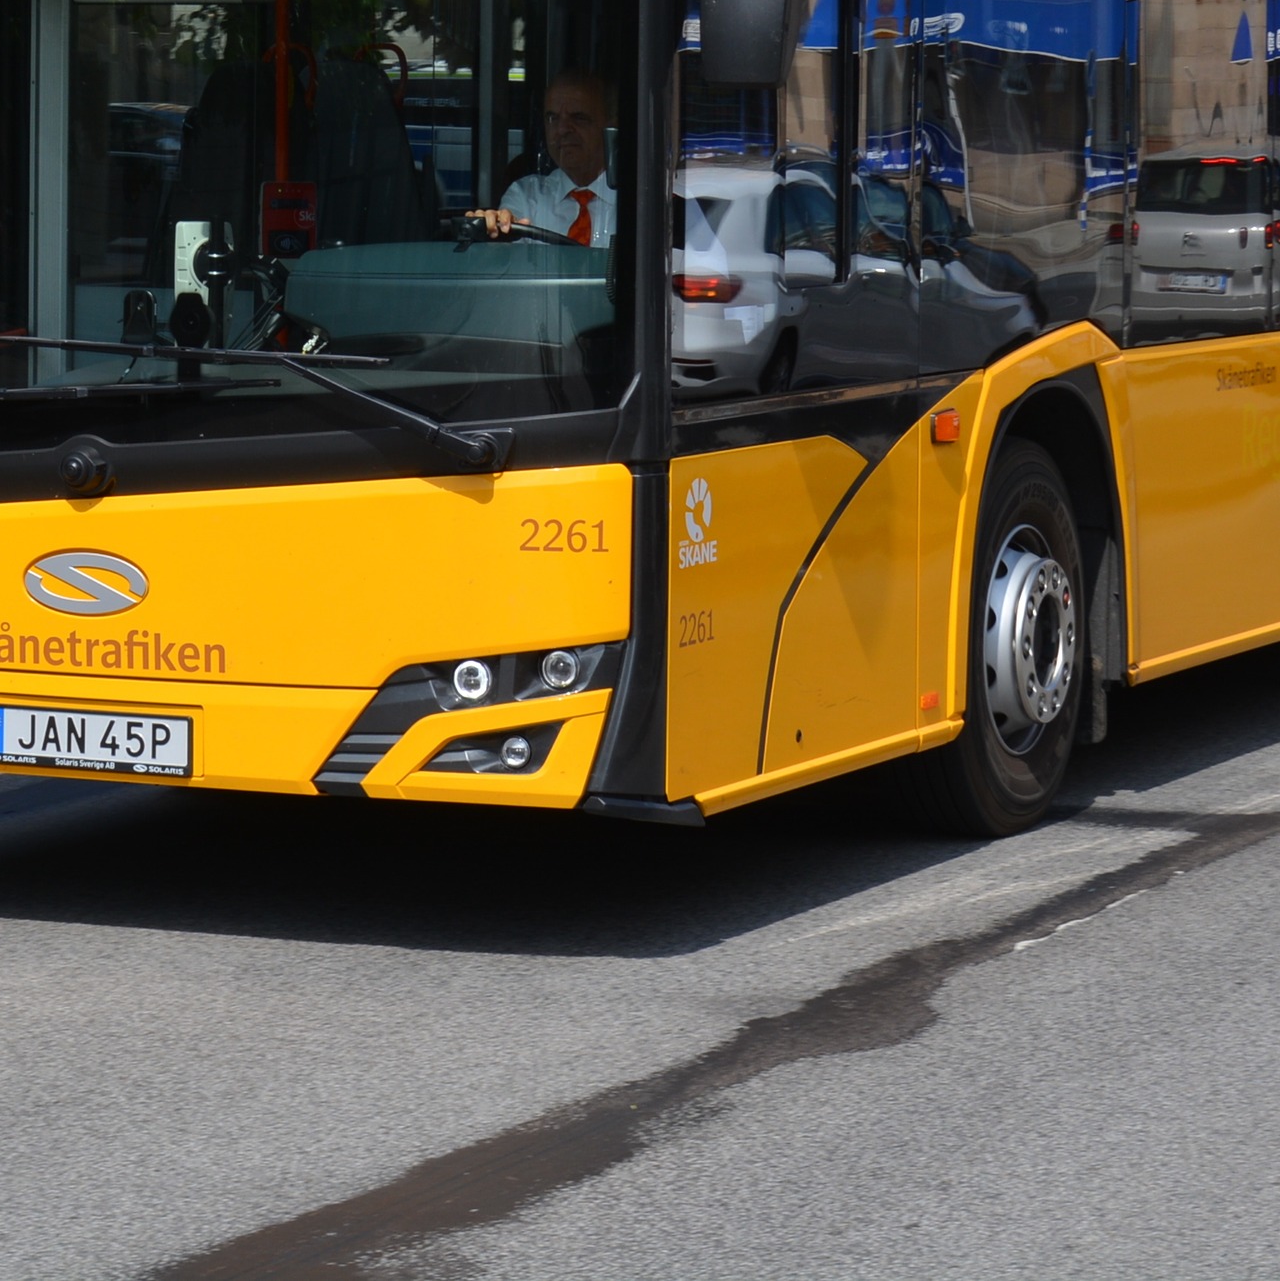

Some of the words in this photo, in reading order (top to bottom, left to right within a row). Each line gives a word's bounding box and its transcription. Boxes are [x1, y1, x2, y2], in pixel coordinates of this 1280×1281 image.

[1216, 361, 1276, 391] Skånetrafiken
[519, 518, 609, 553] 2261
[678, 609, 715, 648] 2261
[18, 714, 85, 754] JAN
[100, 720, 171, 759] 45P
[2, 754, 37, 764] SOLARIS
[55, 758, 79, 767] Solaris
[79, 758, 104, 770] Sverige
[104, 760, 115, 770] AB
[148, 765, 184, 776] SOLARIS
